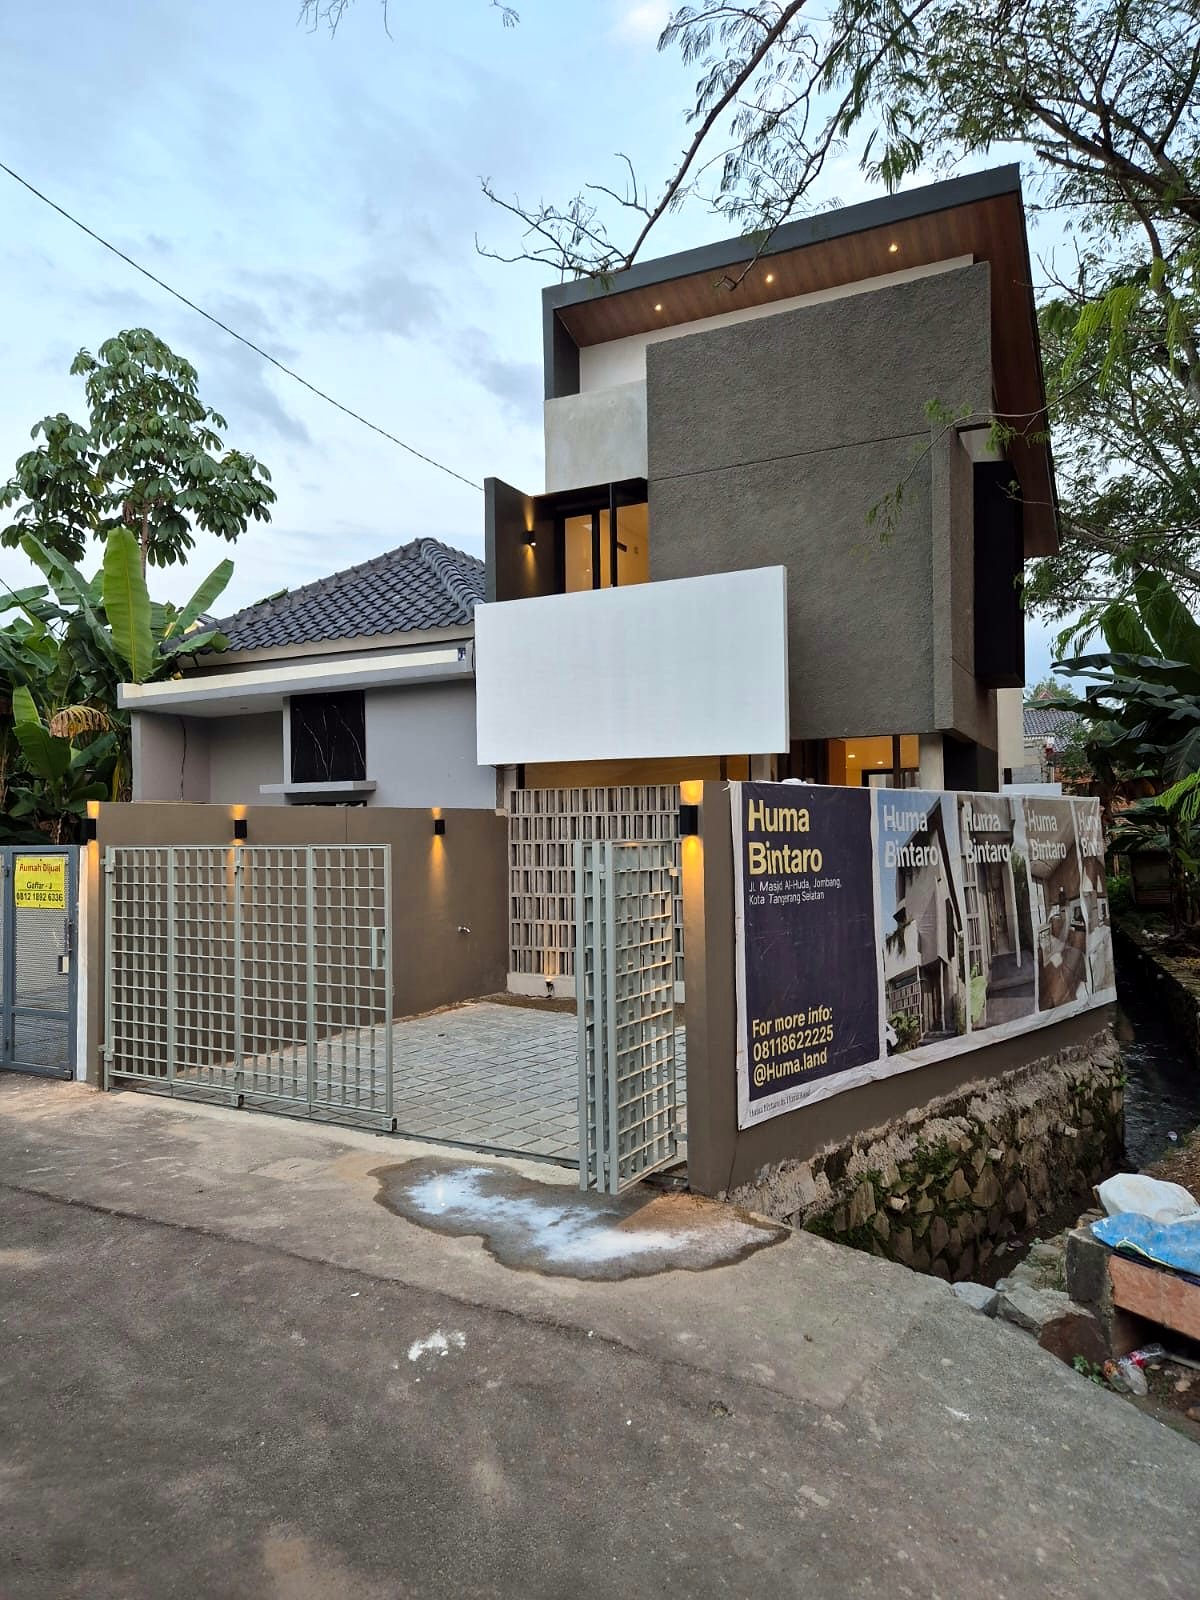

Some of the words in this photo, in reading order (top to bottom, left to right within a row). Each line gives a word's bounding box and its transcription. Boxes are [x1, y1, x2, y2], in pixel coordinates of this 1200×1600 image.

[748, 798, 810, 832] Huma
[883, 804, 929, 832] Huma
[963, 800, 1001, 832] Huma
[1027, 809, 1058, 832] Huma
[748, 841, 823, 875] Bintaro
[885, 839, 939, 868] Bintaro
[966, 838, 1010, 864] Bintaro
[1030, 838, 1067, 860] Bintaro
[20, 863, 41, 872] Rumah
[42, 863, 61, 874] Dijual
[749, 894, 766, 905] Kota
[768, 892, 801, 906] Tangerang
[801, 891, 825, 901] Selatan
[760, 881, 783, 893] Masjid
[752, 1018, 772, 1038] For
[774, 1012, 806, 1033] more
[808, 1004, 833, 1024] info:
[753, 1024, 834, 1062] 08118622225
[753, 1047, 828, 1087] @Huma.land
